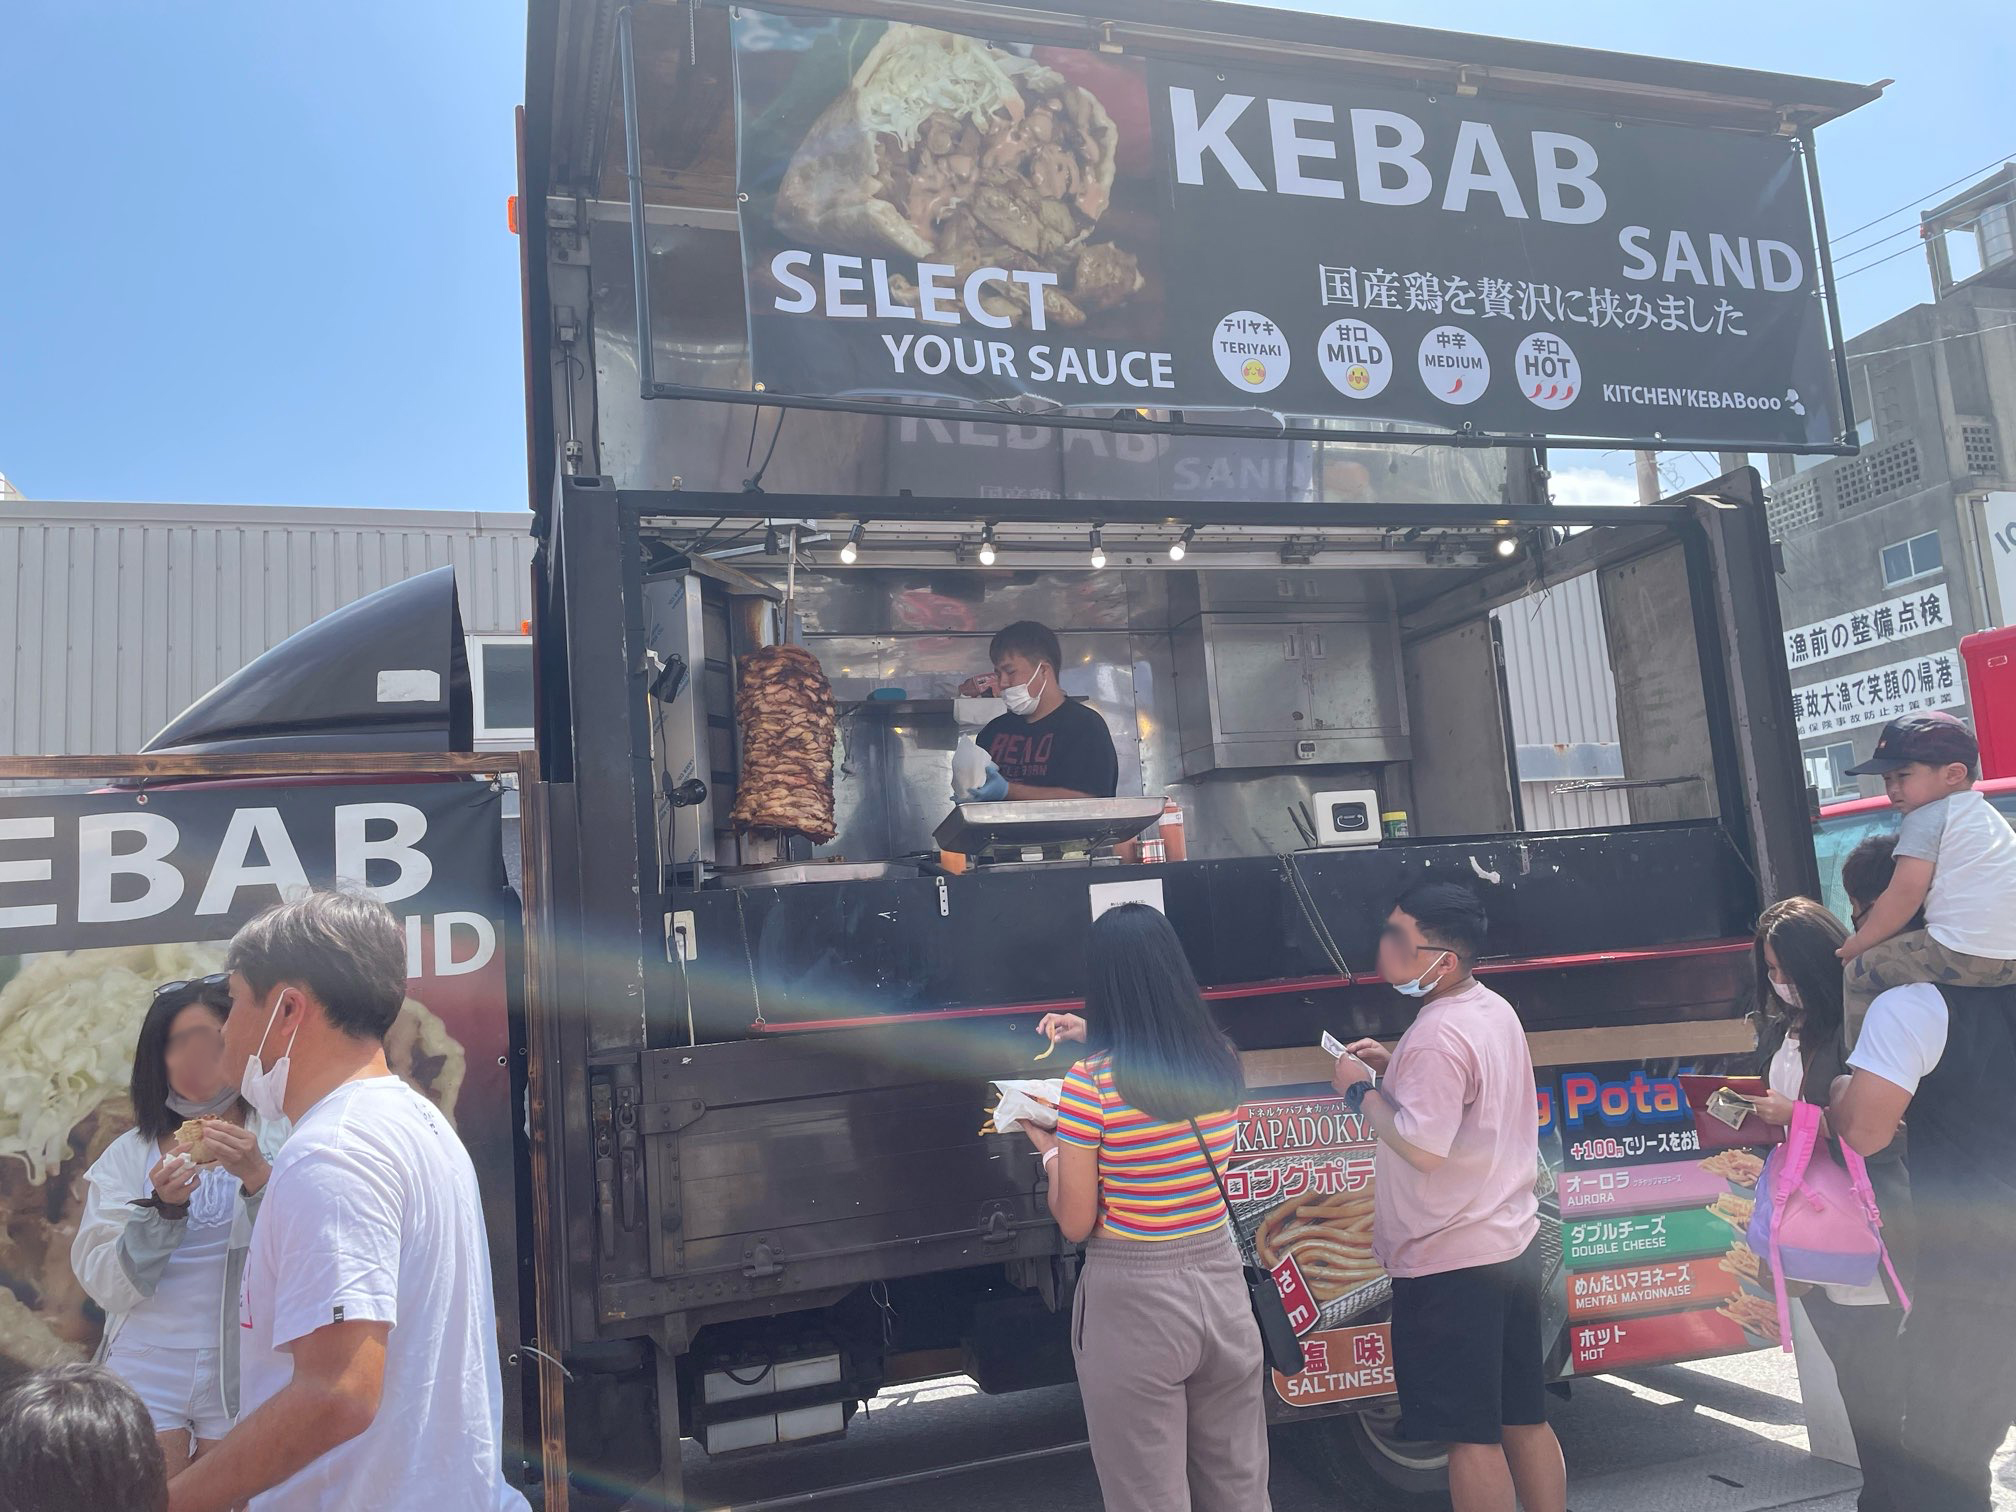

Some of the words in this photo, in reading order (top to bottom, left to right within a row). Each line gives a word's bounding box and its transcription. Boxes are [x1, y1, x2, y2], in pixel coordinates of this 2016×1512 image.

[1168, 86, 1607, 226] KEBAB
[1617, 225, 1804, 292] SAND
[770, 249, 1058, 331] SELECT
[1318, 263, 1748, 336] 国産鶏を贅沢に挟みました
[1223, 318, 1275, 336] テリヤキ
[1336, 324, 1368, 343] 甘口
[1220, 341, 1283, 357] TERIYAKI
[1436, 331, 1467, 350] 中辛
[1532, 338, 1560, 356] 辛口
[881, 334, 1019, 378] YOUR
[1029, 345, 1176, 389] SAUCE
[1327, 343, 1383, 365] MILD
[1425, 354, 1483, 370] MEDIUM
[1524, 354, 1571, 379] HOT
[1789, 592, 1943, 663] 漁前の整備点検
[1565, 1074, 1692, 1122] Pota
[1223, 1157, 1376, 1202] ロングポテ
[1567, 1171, 1630, 1193] オーロラ
[1567, 1192, 1615, 1207] AURORA
[1571, 1215, 1667, 1244] ダブルチーズ
[1572, 1242, 1619, 1257] DOUBLE
[1622, 1236, 1667, 1251] CHEESE
[1574, 1263, 1691, 1296] めんたいマヨネーズ
[1576, 1294, 1618, 1309] MENTAI
[1621, 1284, 1691, 1303] MAYONNAISE
[1579, 1325, 1627, 1348] ホット
[1580, 1347, 1605, 1361] HOT
[1287, 1366, 1395, 1397] SALTINESS
